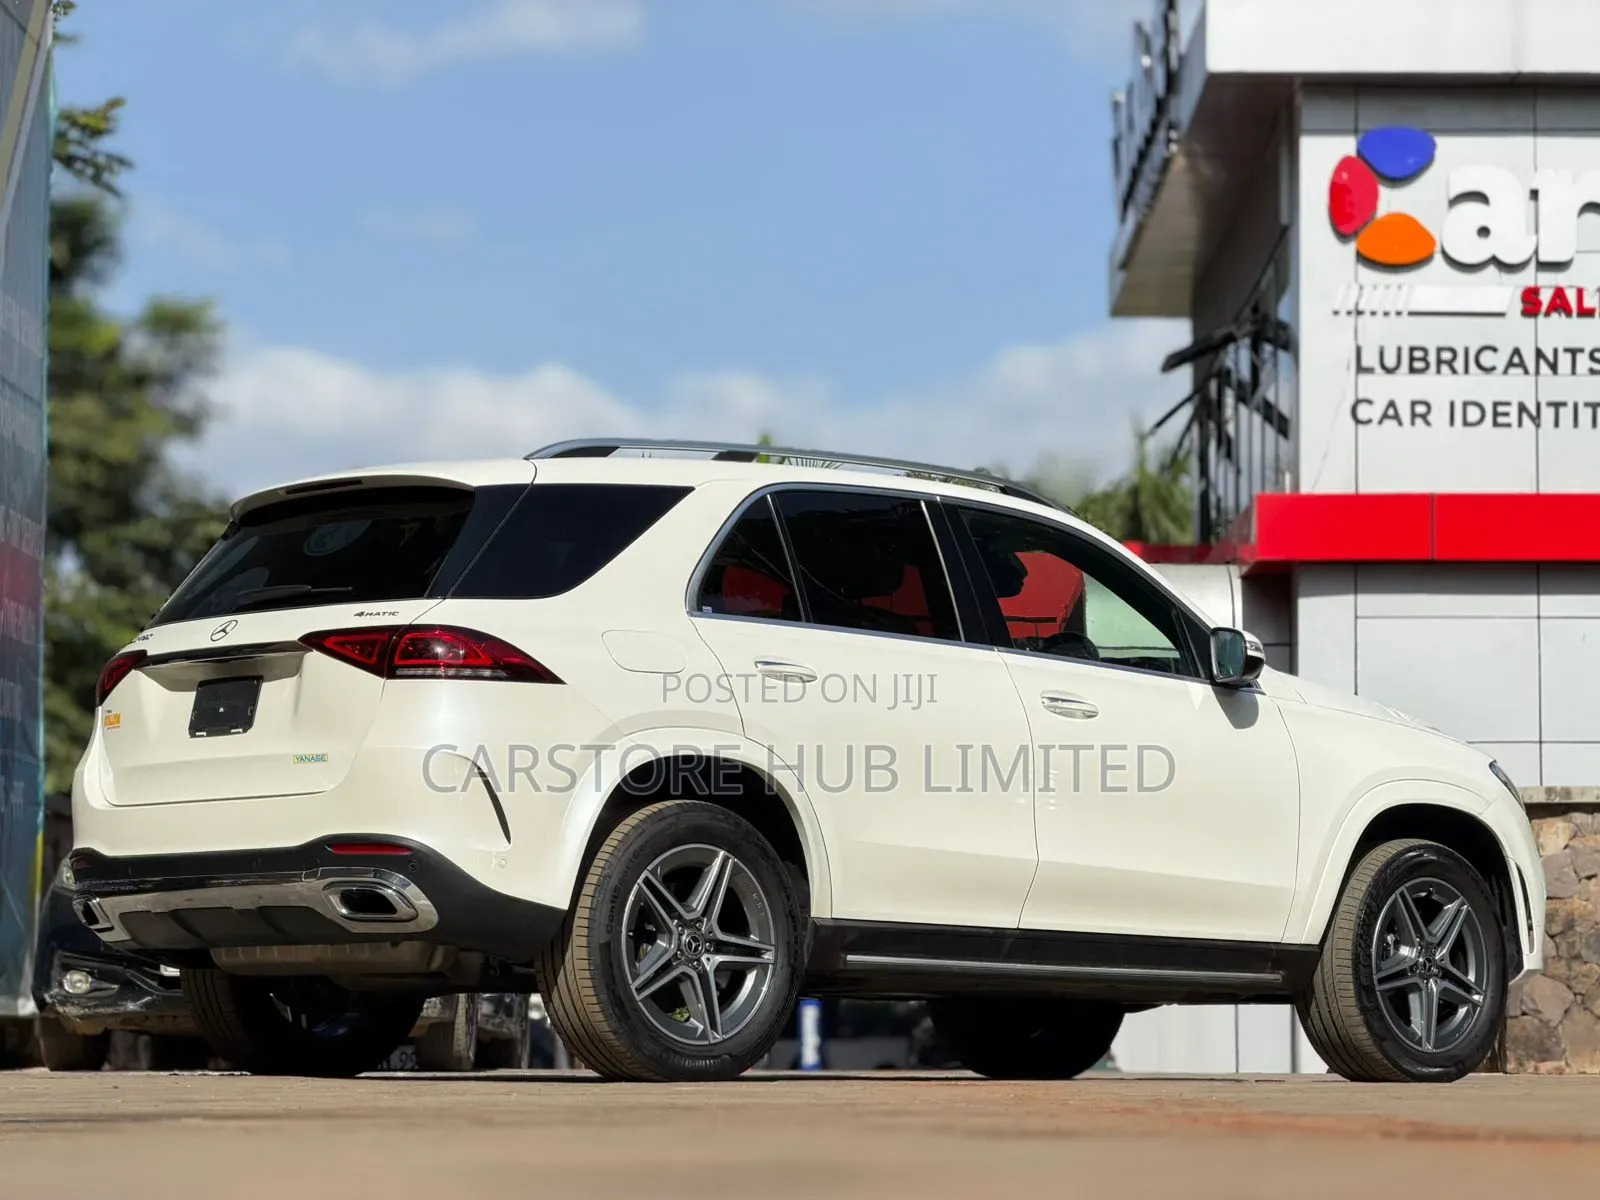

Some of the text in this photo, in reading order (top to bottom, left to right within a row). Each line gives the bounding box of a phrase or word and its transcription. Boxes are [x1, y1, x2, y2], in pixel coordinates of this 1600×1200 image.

[1521, 285, 1600, 318] SAL
[1351, 398, 1600, 429] CAR IDENTIT
